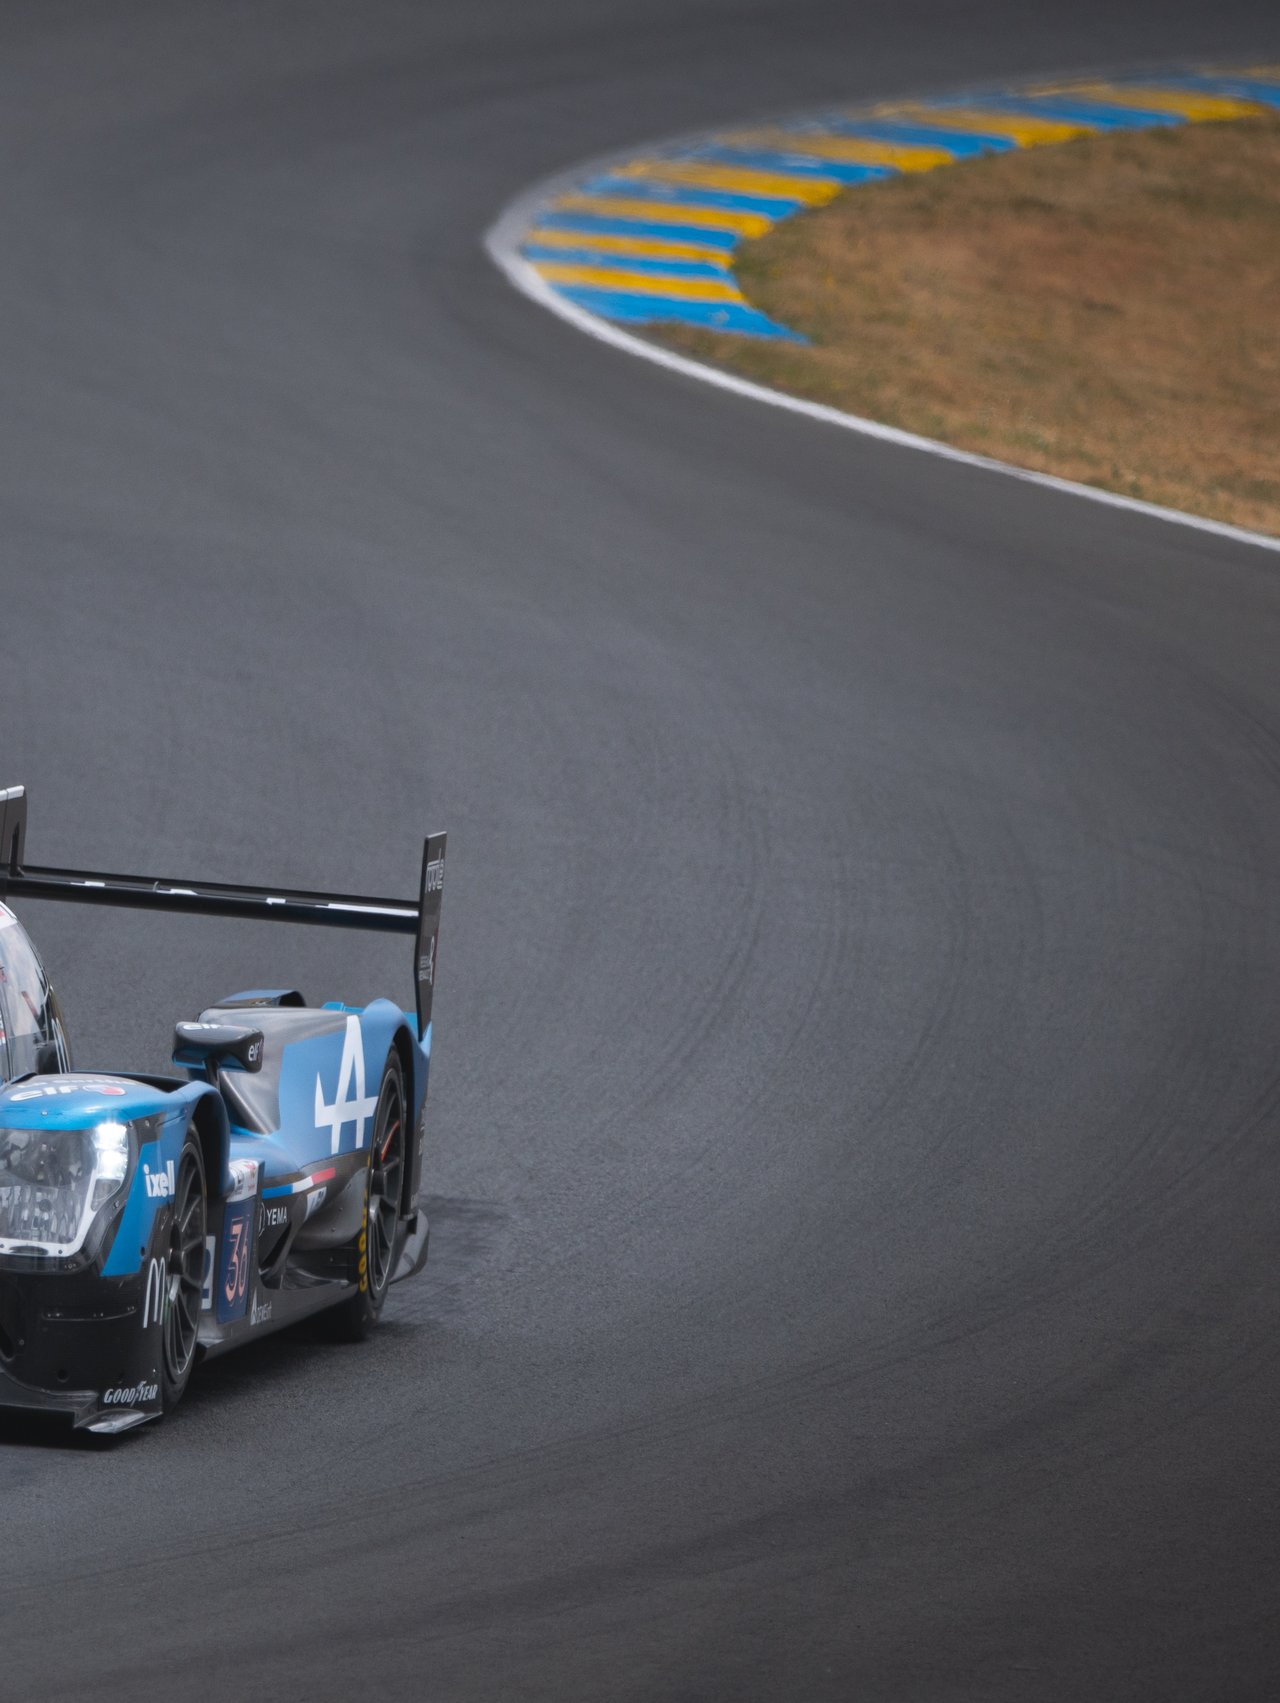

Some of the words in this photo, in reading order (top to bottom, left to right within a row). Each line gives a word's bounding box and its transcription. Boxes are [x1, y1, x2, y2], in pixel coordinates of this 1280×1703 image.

[142, 1160, 176, 1198] ixell
[267, 1206, 288, 1227] YEMA
[225, 1214, 251, 1307] 36
[103, 1380, 159, 1408] GOODYEAR
